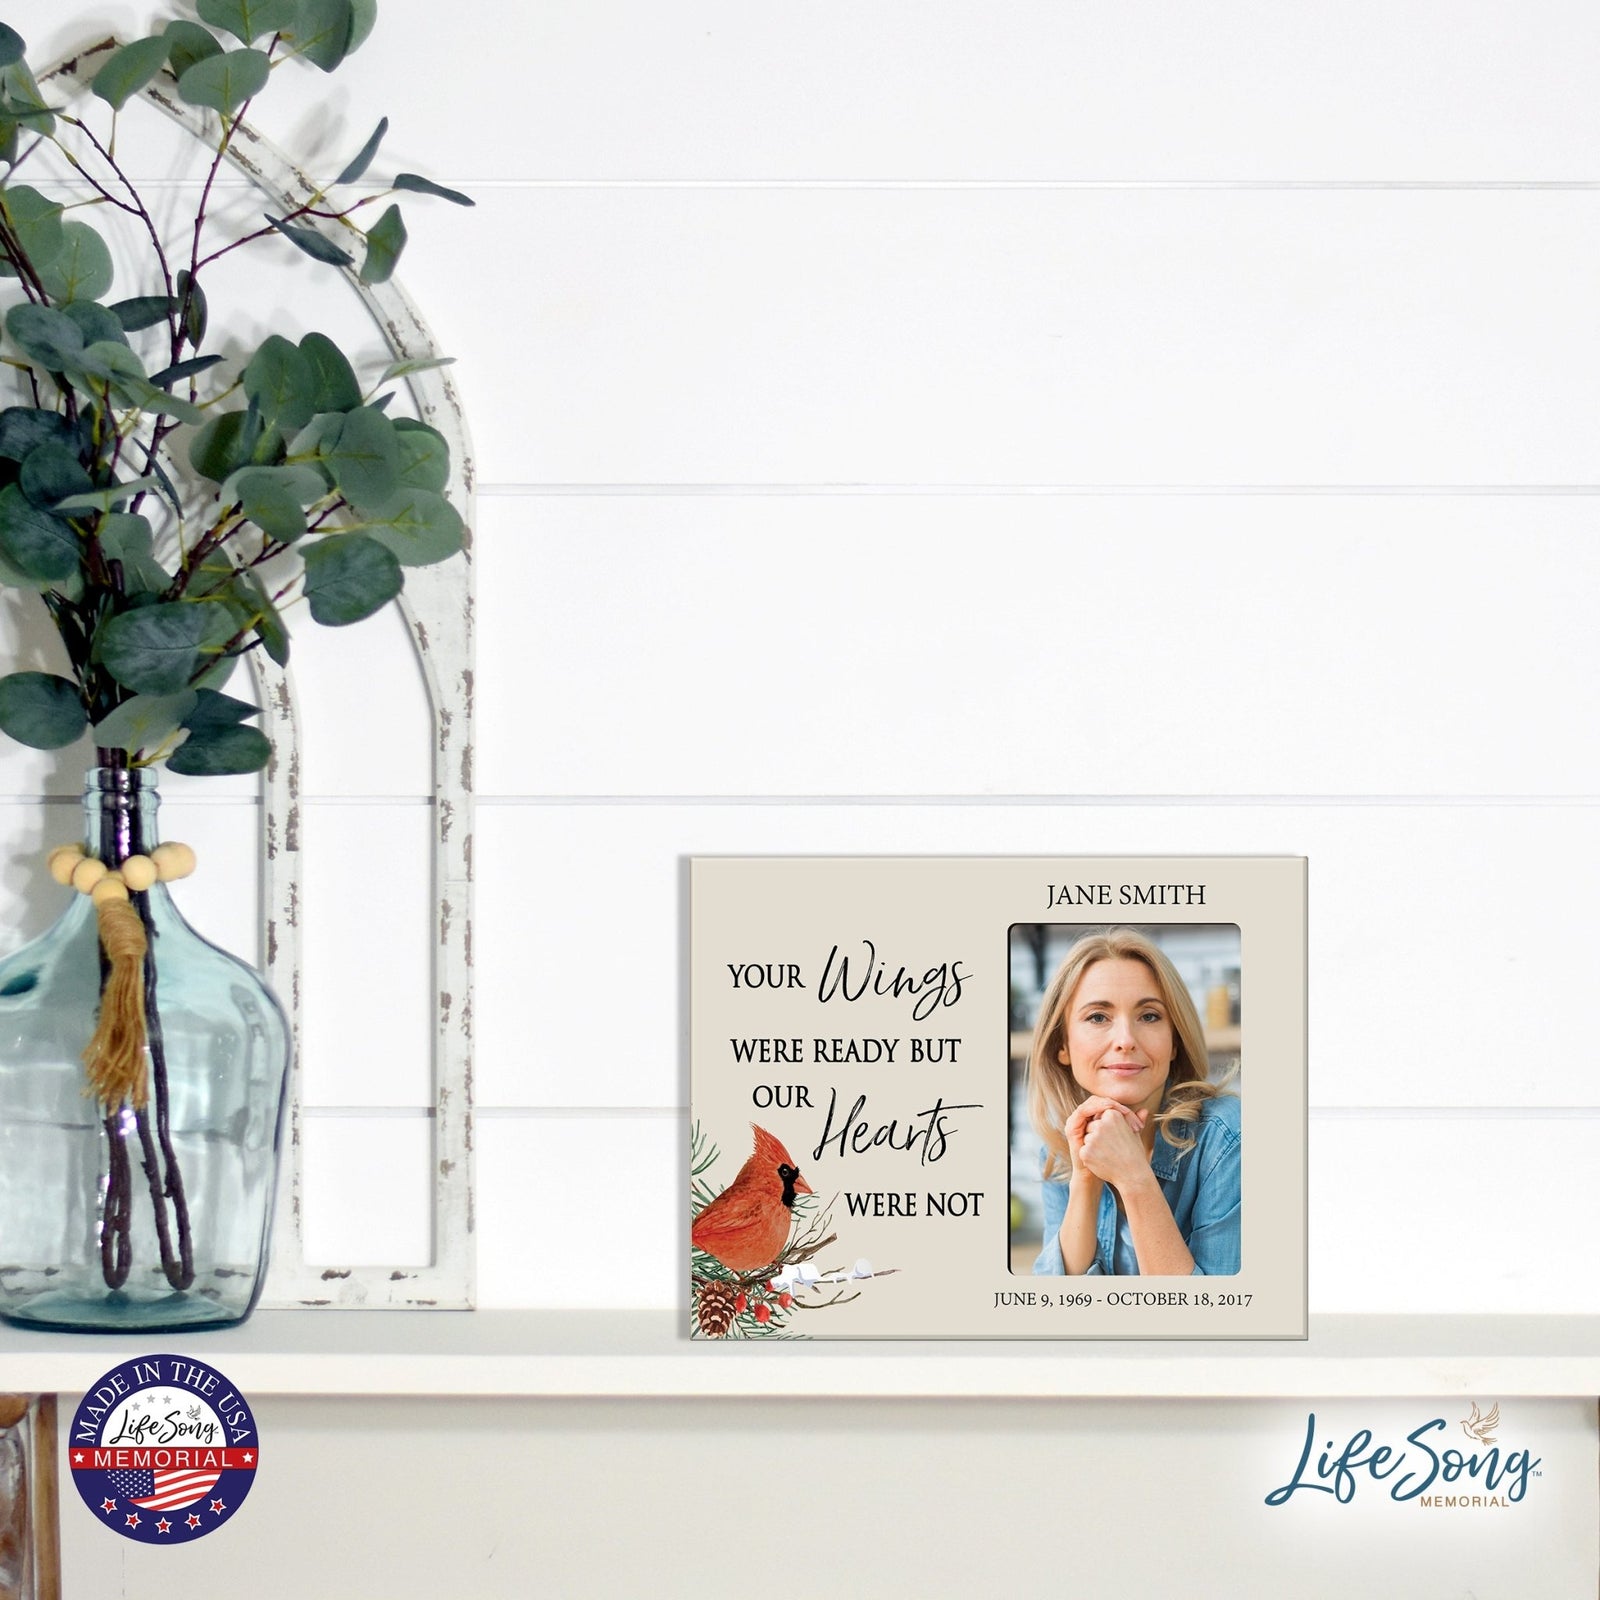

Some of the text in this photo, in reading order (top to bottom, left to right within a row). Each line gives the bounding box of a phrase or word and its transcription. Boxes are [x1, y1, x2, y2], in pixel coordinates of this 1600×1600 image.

[1046, 883, 1207, 910] JANE SMITH
[727, 940, 974, 1021] YOUR Wings
[731, 1038, 962, 1063] WERE READY BUT
[752, 1085, 984, 1166] OUR Hearts
[845, 1192, 985, 1217] WERE NOT
[994, 1292, 1036, 1308] JUNE
[1040, 1292, 1053, 1307] 9,
[1057, 1292, 1093, 1307] 1969
[1106, 1292, 1189, 1307] OCTOBER
[1193, 1292, 1216, 1307] 18,
[1218, 1292, 1253, 1307] 2017
